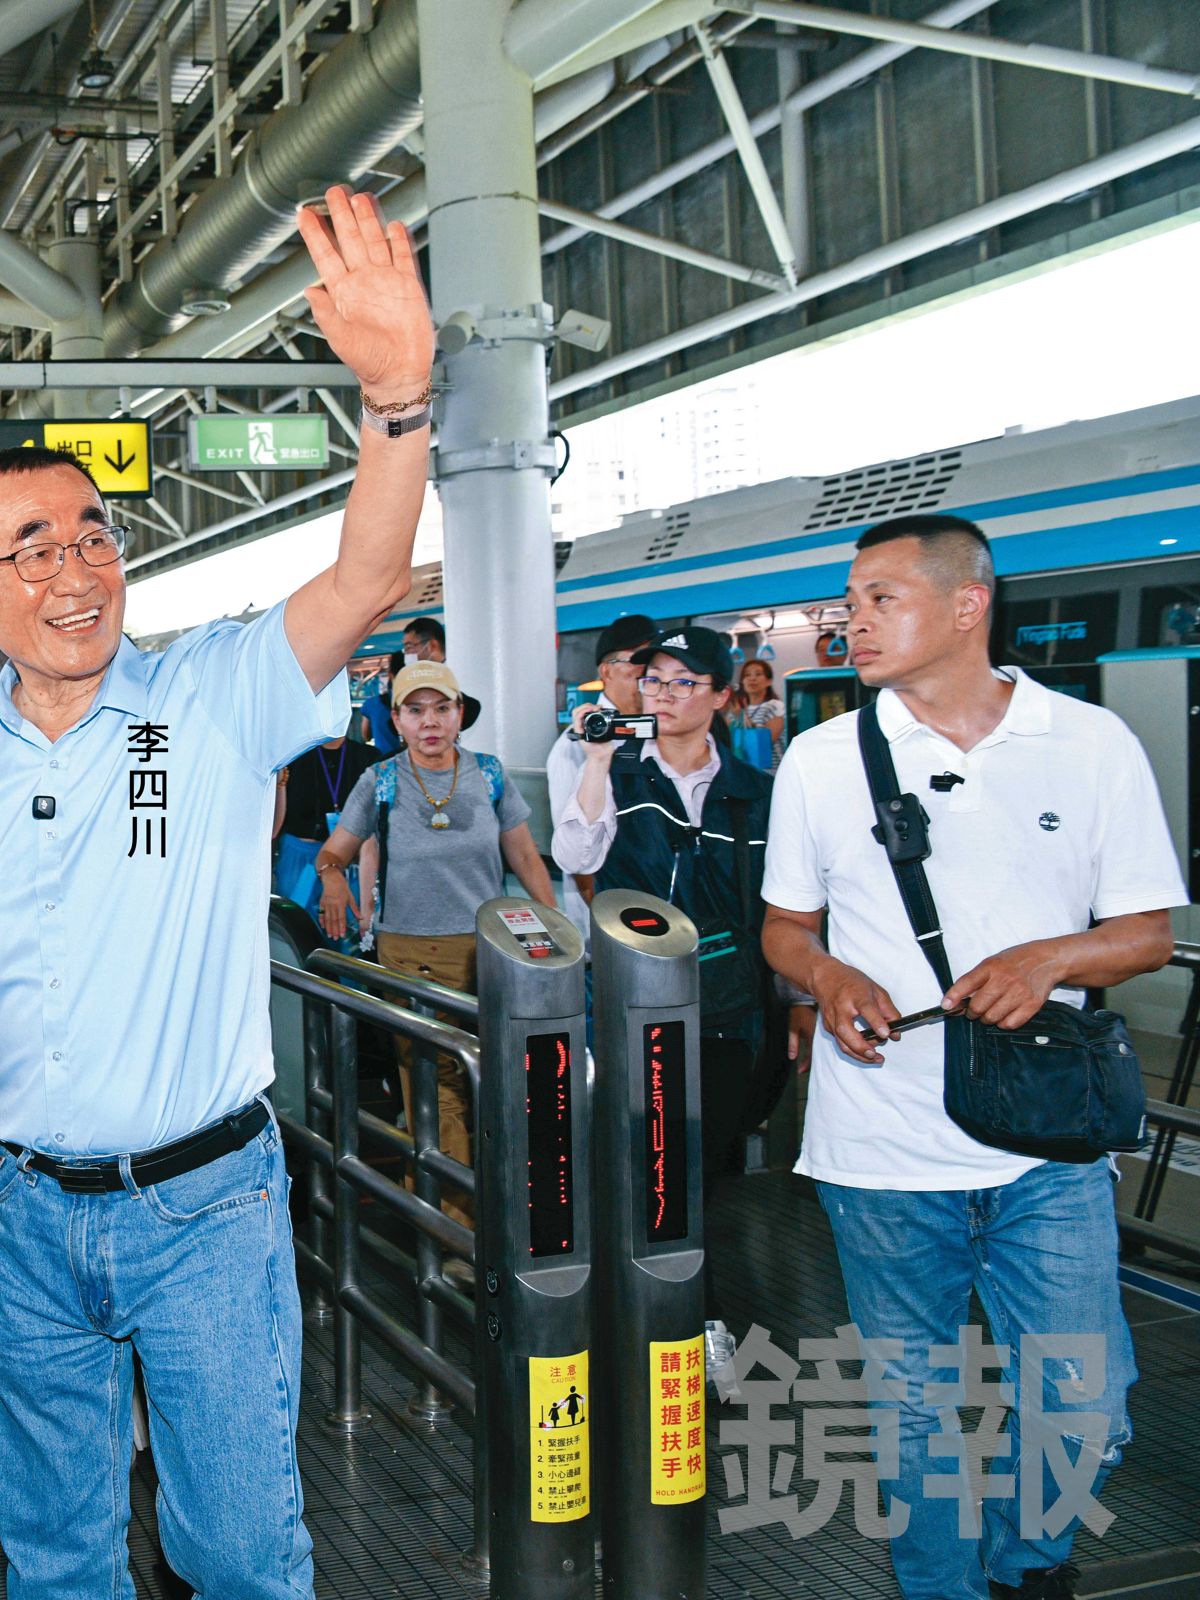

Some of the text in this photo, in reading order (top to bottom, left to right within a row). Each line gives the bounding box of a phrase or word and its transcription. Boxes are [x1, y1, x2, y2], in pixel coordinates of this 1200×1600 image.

[206, 448, 244, 459] EXIT
[660, 1352, 682, 1479] 請緊握扶手
[685, 1347, 702, 1476] 扶梯速度快
